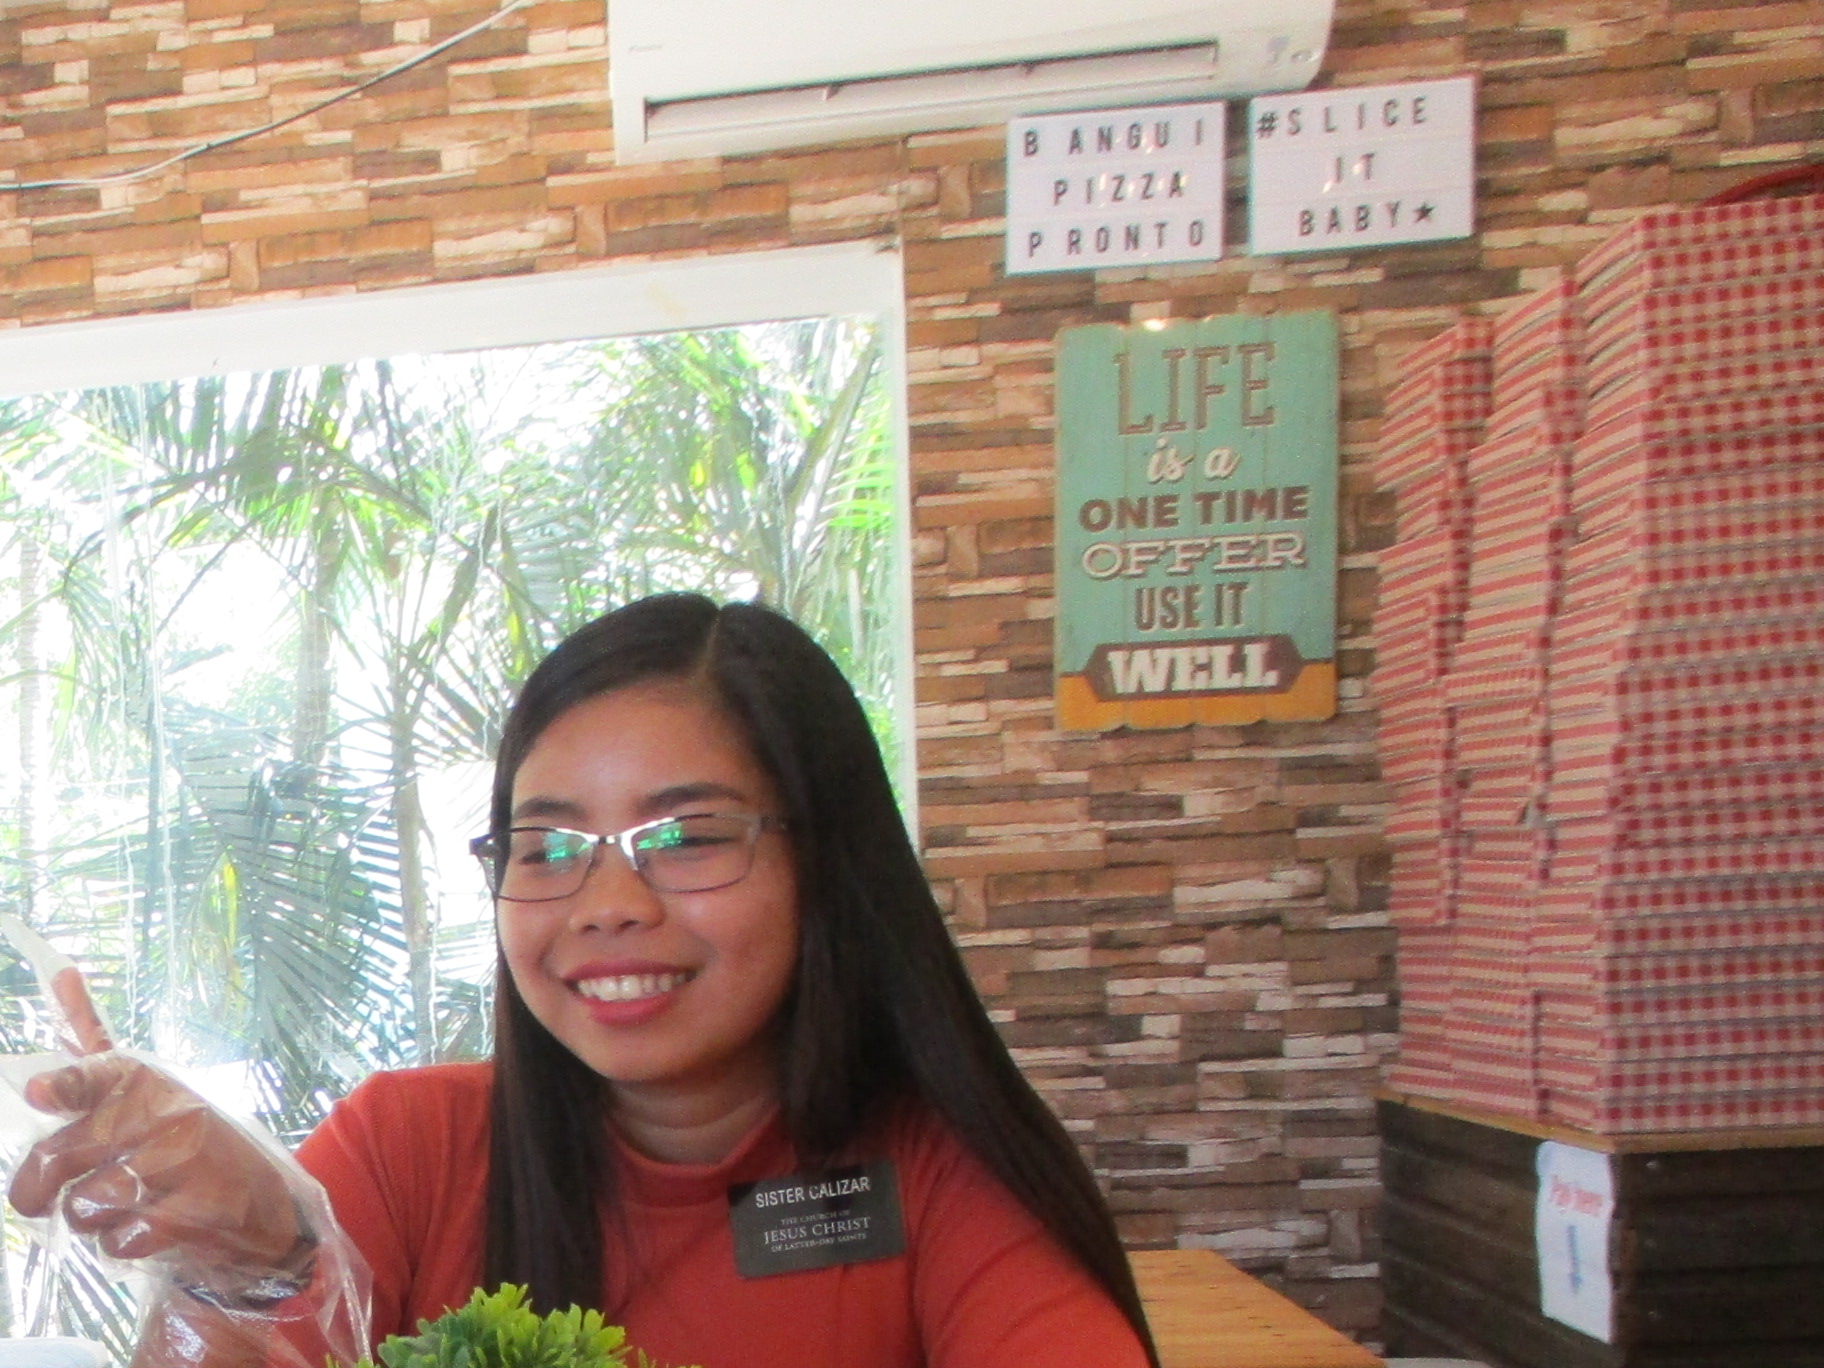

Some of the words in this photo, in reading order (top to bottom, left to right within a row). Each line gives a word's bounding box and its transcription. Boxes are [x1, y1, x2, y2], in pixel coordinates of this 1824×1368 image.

[1023, 117, 1204, 157] BANGUI
[1256, 96, 1429, 139] #SLICE
[1053, 170, 1186, 206] PIZZA
[1333, 152, 1376, 183] IT
[1027, 219, 1204, 258] PRONTO
[1113, 341, 1276, 436] LIFE
[1146, 437, 1194, 484] is
[1204, 445, 1242, 480] a
[1079, 492, 1181, 533] ONE
[1192, 485, 1311, 525] TIME
[1082, 531, 1307, 579] OFFER
[1135, 584, 1202, 632] USE
[1213, 582, 1250, 629] IT
[1107, 642, 1279, 696] WELL
[755, 1186, 805, 1209] SISTER
[809, 1176, 871, 1200] CALIZAR
[763, 1225, 807, 1245] JESUS
[812, 1216, 870, 1235] CHRIST
